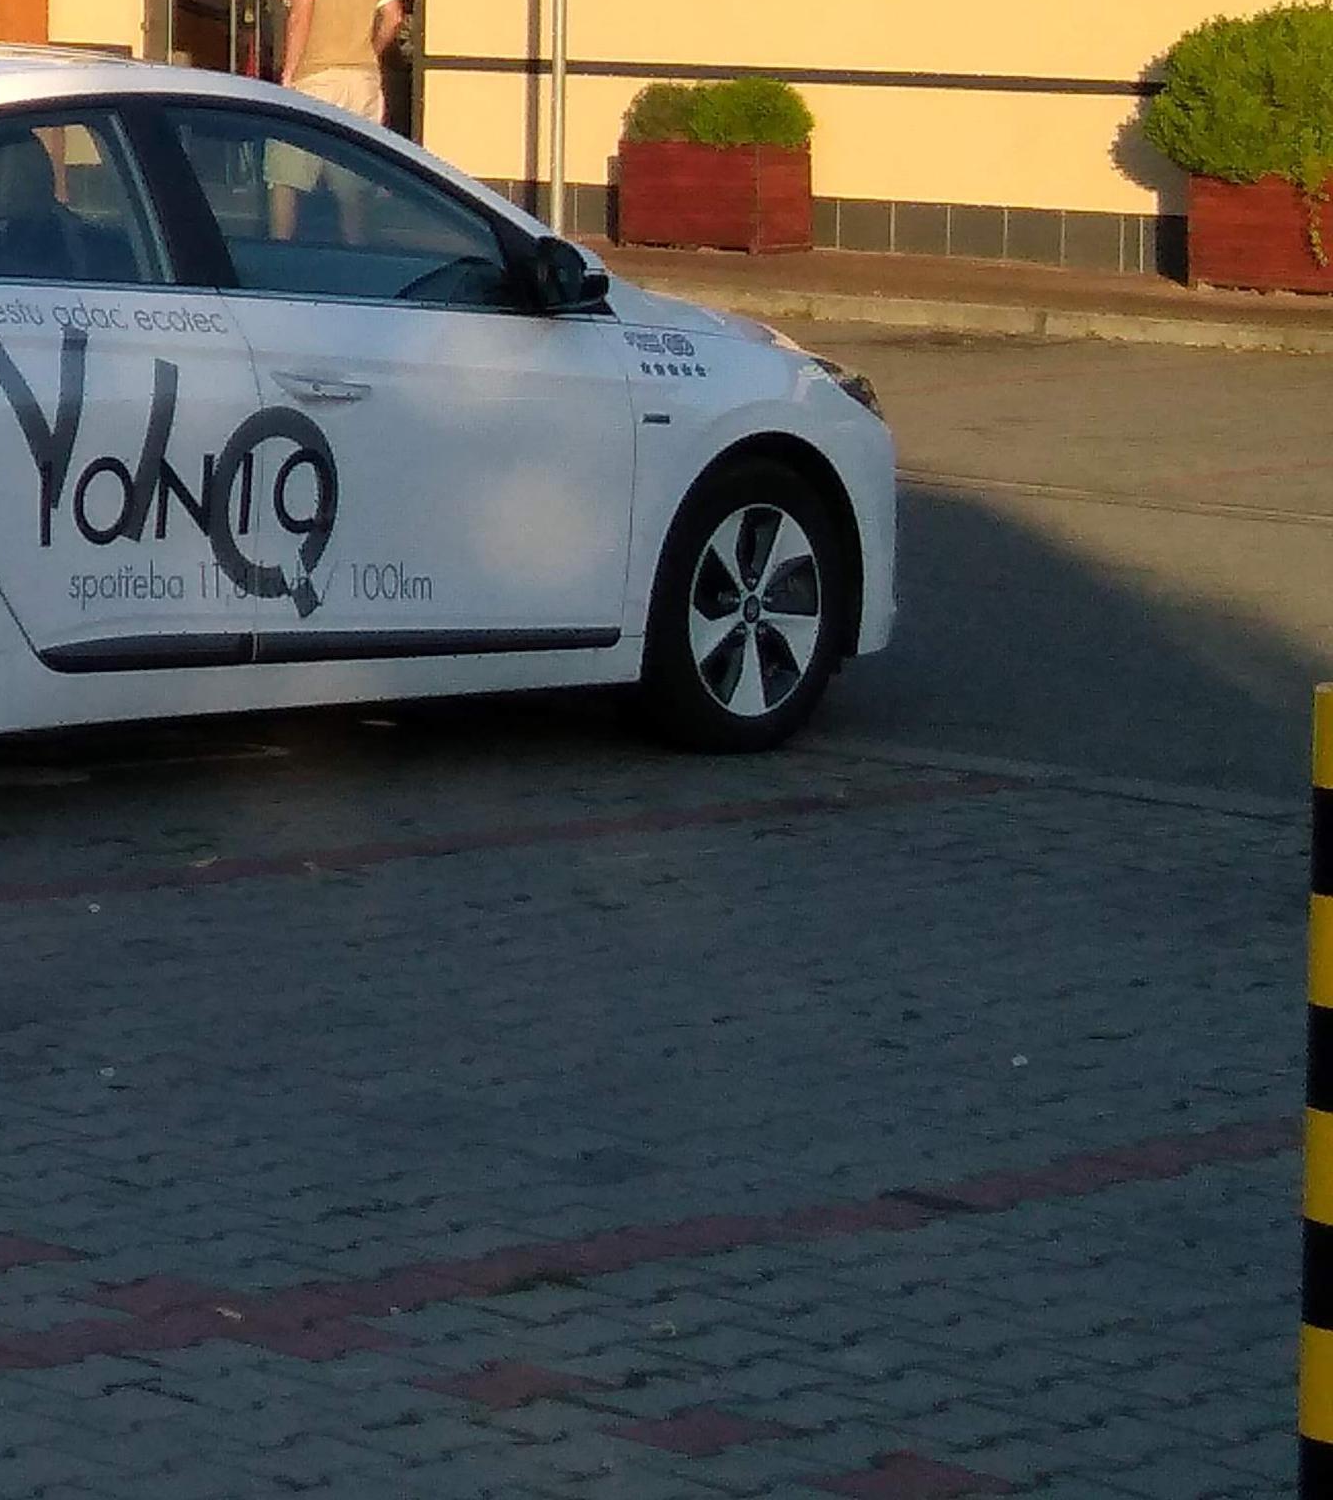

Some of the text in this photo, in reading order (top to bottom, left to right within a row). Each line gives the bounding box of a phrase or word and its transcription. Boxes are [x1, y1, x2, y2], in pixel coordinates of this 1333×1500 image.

[39, 445, 339, 549] IONIQ
[68, 560, 185, 611] spotřeba
[350, 561, 434, 601] 100km
